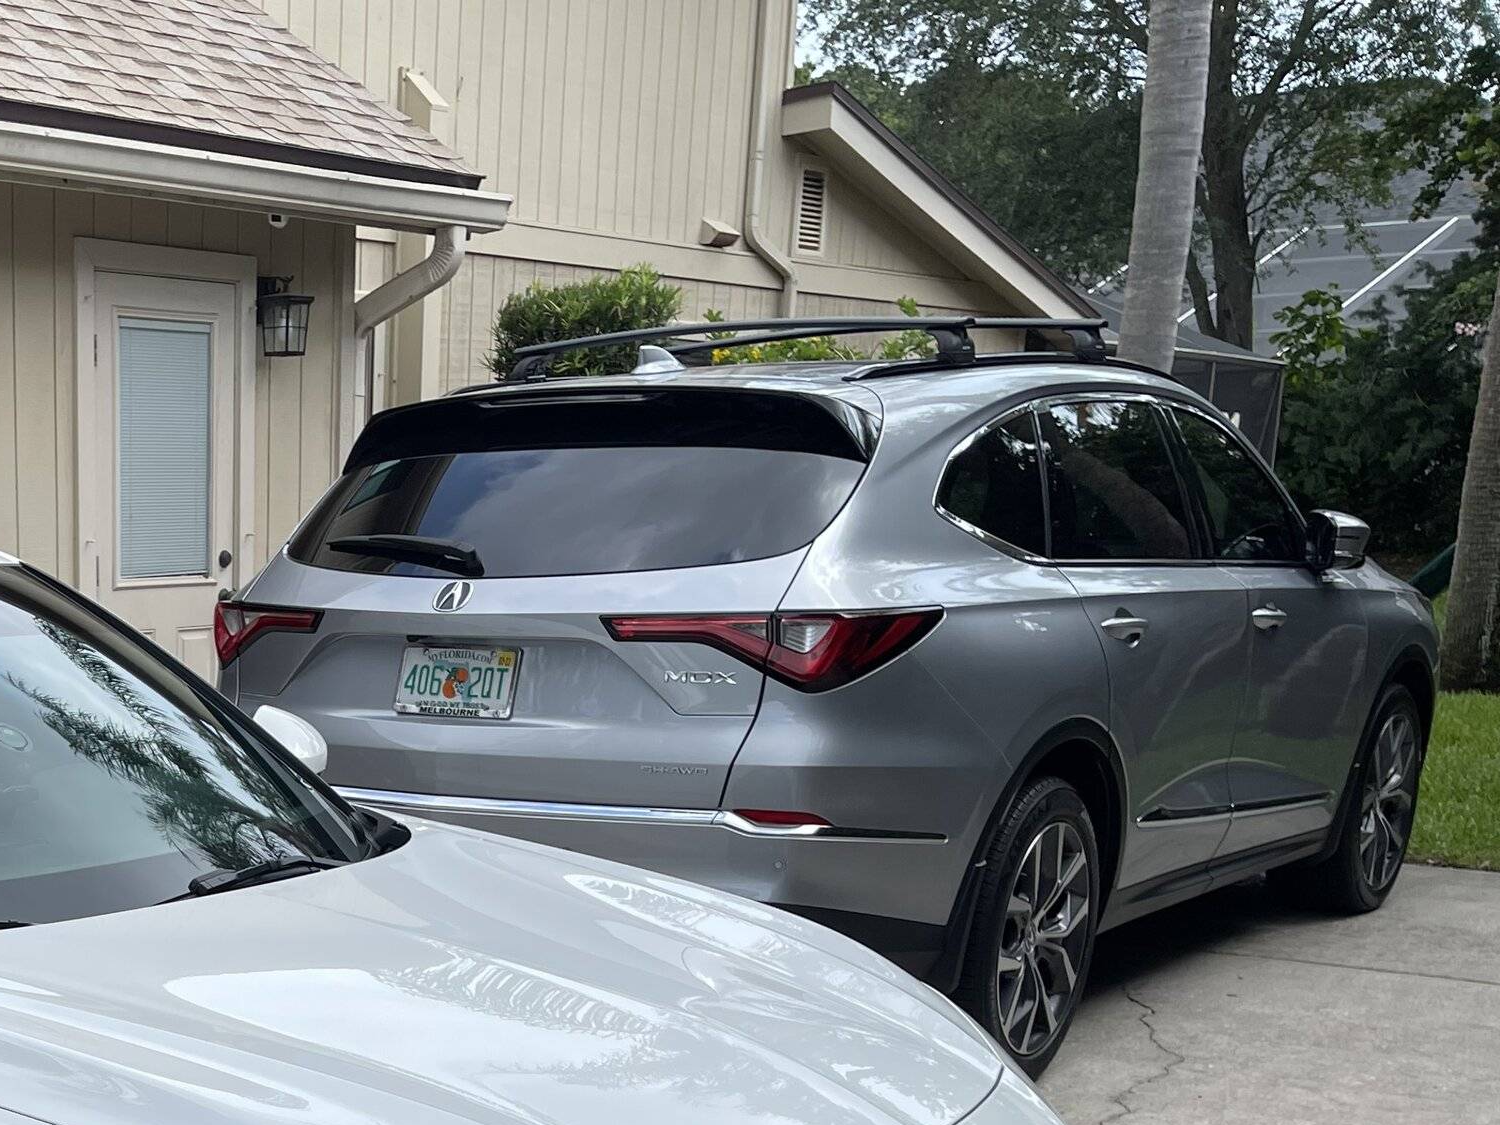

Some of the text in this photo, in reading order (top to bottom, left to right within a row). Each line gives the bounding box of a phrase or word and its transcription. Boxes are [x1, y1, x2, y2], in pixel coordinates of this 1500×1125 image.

[404, 664, 444, 695] 406
[664, 670, 737, 685] MDX
[419, 706, 480, 716] MELBOURNE
